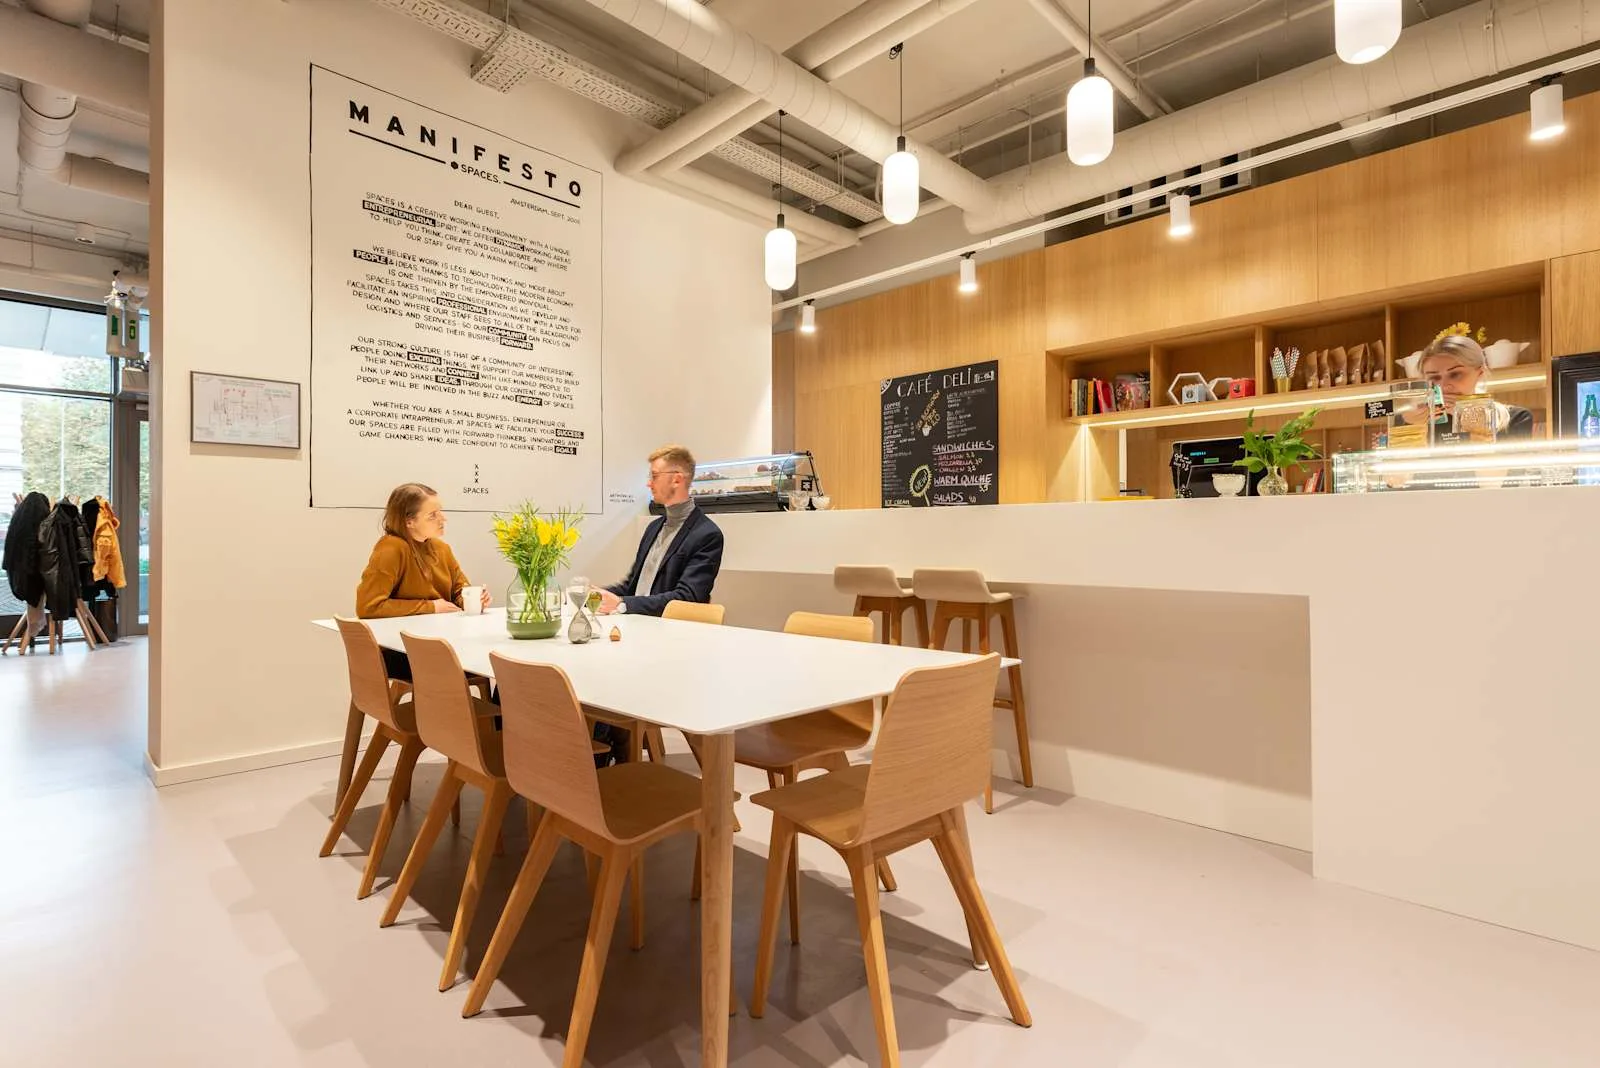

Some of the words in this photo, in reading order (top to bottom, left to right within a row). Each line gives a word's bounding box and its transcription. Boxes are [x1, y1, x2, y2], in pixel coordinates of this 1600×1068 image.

[349, 100, 581, 197] MANIFESTO
[461, 164, 501, 184] SPACES.
[366, 191, 394, 205] SPACES
[415, 205, 446, 220] CREATIVE
[450, 215, 479, 230] WORKING
[482, 225, 526, 243] ENVIRONMENT
[529, 238, 542, 248] WITH
[454, 200, 472, 211] DEAR
[364, 200, 434, 226] ENTREPRENEURIAL
[474, 231, 493, 242] OFFER
[525, 246, 550, 258] WORKING
[382, 216, 401, 227] HELP
[405, 222, 418, 231] YOU
[445, 233, 470, 245] CREATE
[473, 240, 487, 250] AND
[490, 245, 529, 261] COLLABORATE
[532, 256, 544, 265] AND
[547, 260, 567, 271] WHERE
[406, 232, 420, 242] OUR
[447, 243, 461, 252] GIVE
[465, 248, 476, 256] YOU
[486, 253, 505, 264] WARM
[357, 251, 385, 264] PEOPLE
[421, 266, 447, 278] THANKS
[506, 287, 518, 295] THE
[520, 290, 544, 301] MODERN
[387, 248, 415, 261] BELIEVE
[419, 256, 438, 266] WORK
[450, 264, 466, 273] LESS
[470, 269, 488, 278] ABOUT
[491, 274, 512, 284] THINGS
[528, 283, 545, 292] MORE
[548, 288, 564, 297] ABOUT
[398, 270, 413, 280] ONE
[461, 285, 473, 293] THE
[476, 288, 516, 303] EMPOWERED
[347, 279, 385, 293] FACILITATE
[401, 291, 434, 303] INSPIRING
[438, 298, 484, 313] PROFESSIONAL
[488, 309, 530, 323] ENVIRONMENT
[366, 274, 394, 286] SPACES
[397, 280, 418, 291] TAKES
[422, 286, 436, 294] THIS
[440, 290, 454, 298] INTO
[458, 294, 507, 310] CONSIDERATION
[532, 310, 557, 320] DEVELOP
[352, 290, 380, 301] DESIGN
[384, 296, 399, 305] AND
[404, 300, 430, 311] WHERE
[433, 306, 447, 315] OUR
[452, 310, 470, 319] STAFF
[473, 315, 490, 323] SEES
[540, 328, 578, 341] BACKGROUND
[366, 303, 402, 316] LOGISTICS
[406, 311, 420, 319] AND
[489, 327, 525, 339] COMMUNITY
[543, 337, 559, 345] FOCUS
[415, 322, 442, 332] DRIVING
[446, 328, 464, 336] THEIR
[468, 332, 498, 342] BUSINESS
[350, 344, 379, 354] PEOPLE
[383, 349, 406, 358] DOING
[483, 366, 509, 374] SUPPORT
[378, 339, 406, 349] STRONG
[410, 344, 440, 354] CULTURE
[489, 358, 525, 369] COMMUNITY
[357, 375, 385, 384] PEOPLE
[424, 384, 456, 393] INVOLVED
[365, 356, 386, 364] THEIR
[390, 359, 428, 371] NETWORKS
[448, 368, 476, 378] CONNECT
[514, 378, 536, 387] MINDED
[539, 382, 559, 390] PEOPLE
[410, 372, 432, 380] SHARE
[462, 379, 492, 389] THROUGH
[510, 386, 536, 395] CONTENT
[897, 374, 932, 397] CAFÉ
[943, 368, 972, 389] DELI
[372, 400, 408, 410] WHETHER
[355, 409, 397, 419] CORPORATE
[506, 424, 536, 432] FACILITATE
[385, 433, 423, 441] CHANGERS
[530, 436, 565, 444] INNOVATORS
[932, 440, 994, 452] SANDWICHES
[934, 475, 958, 486] WARM
[962, 474, 992, 487] QUICHE
[933, 492, 964, 503] SALADS
